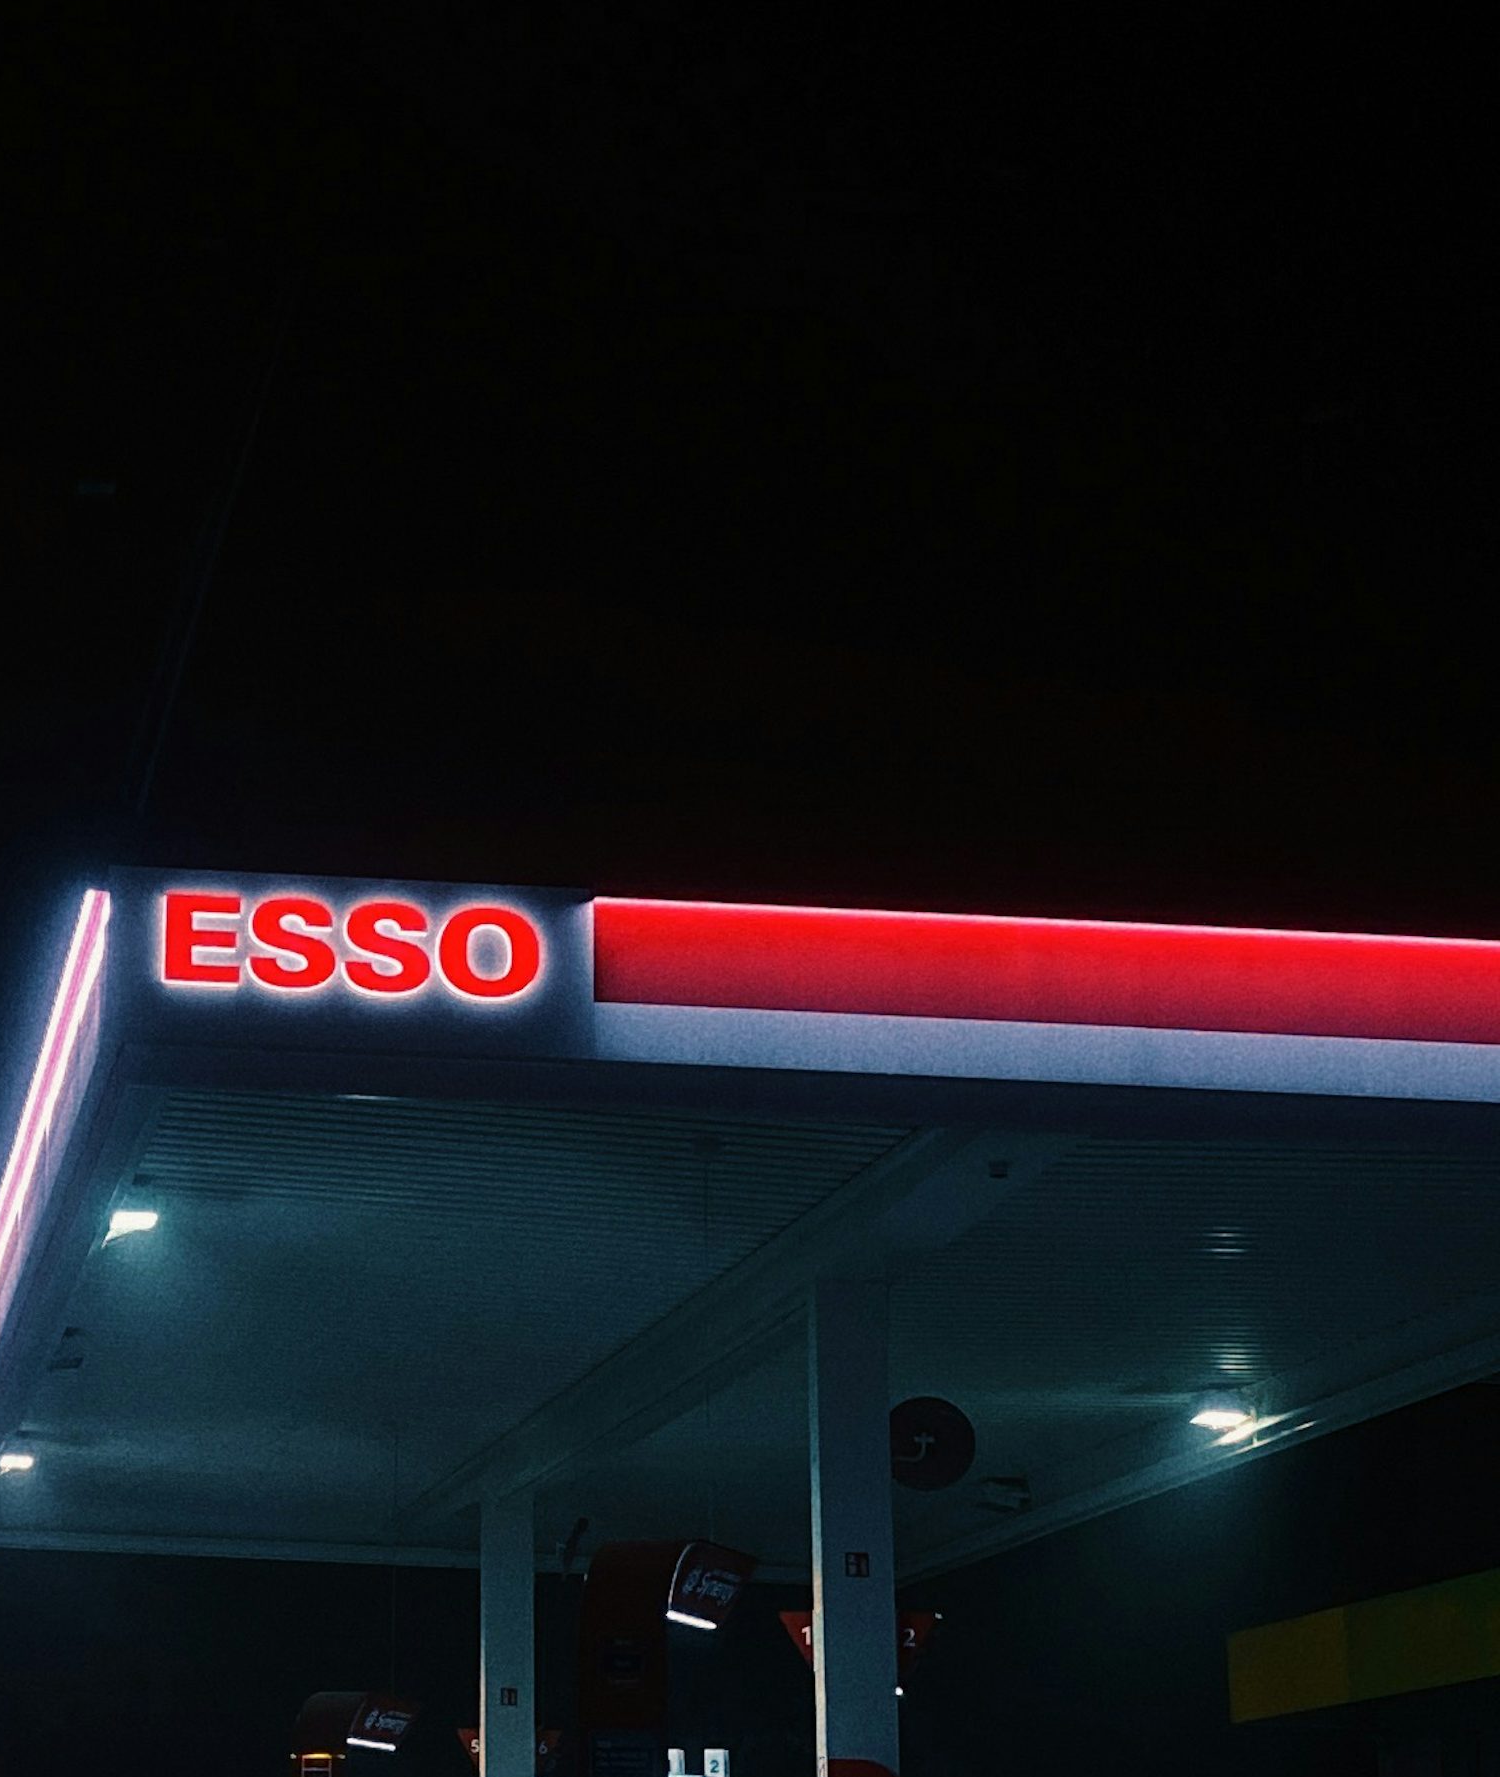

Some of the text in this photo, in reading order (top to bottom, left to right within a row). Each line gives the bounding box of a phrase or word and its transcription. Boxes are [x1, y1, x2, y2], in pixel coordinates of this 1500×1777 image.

[164, 891, 540, 998] ESSO
[801, 1626, 811, 1646] 1
[903, 1628, 916, 1648] 2
[710, 1760, 719, 1773] 2
